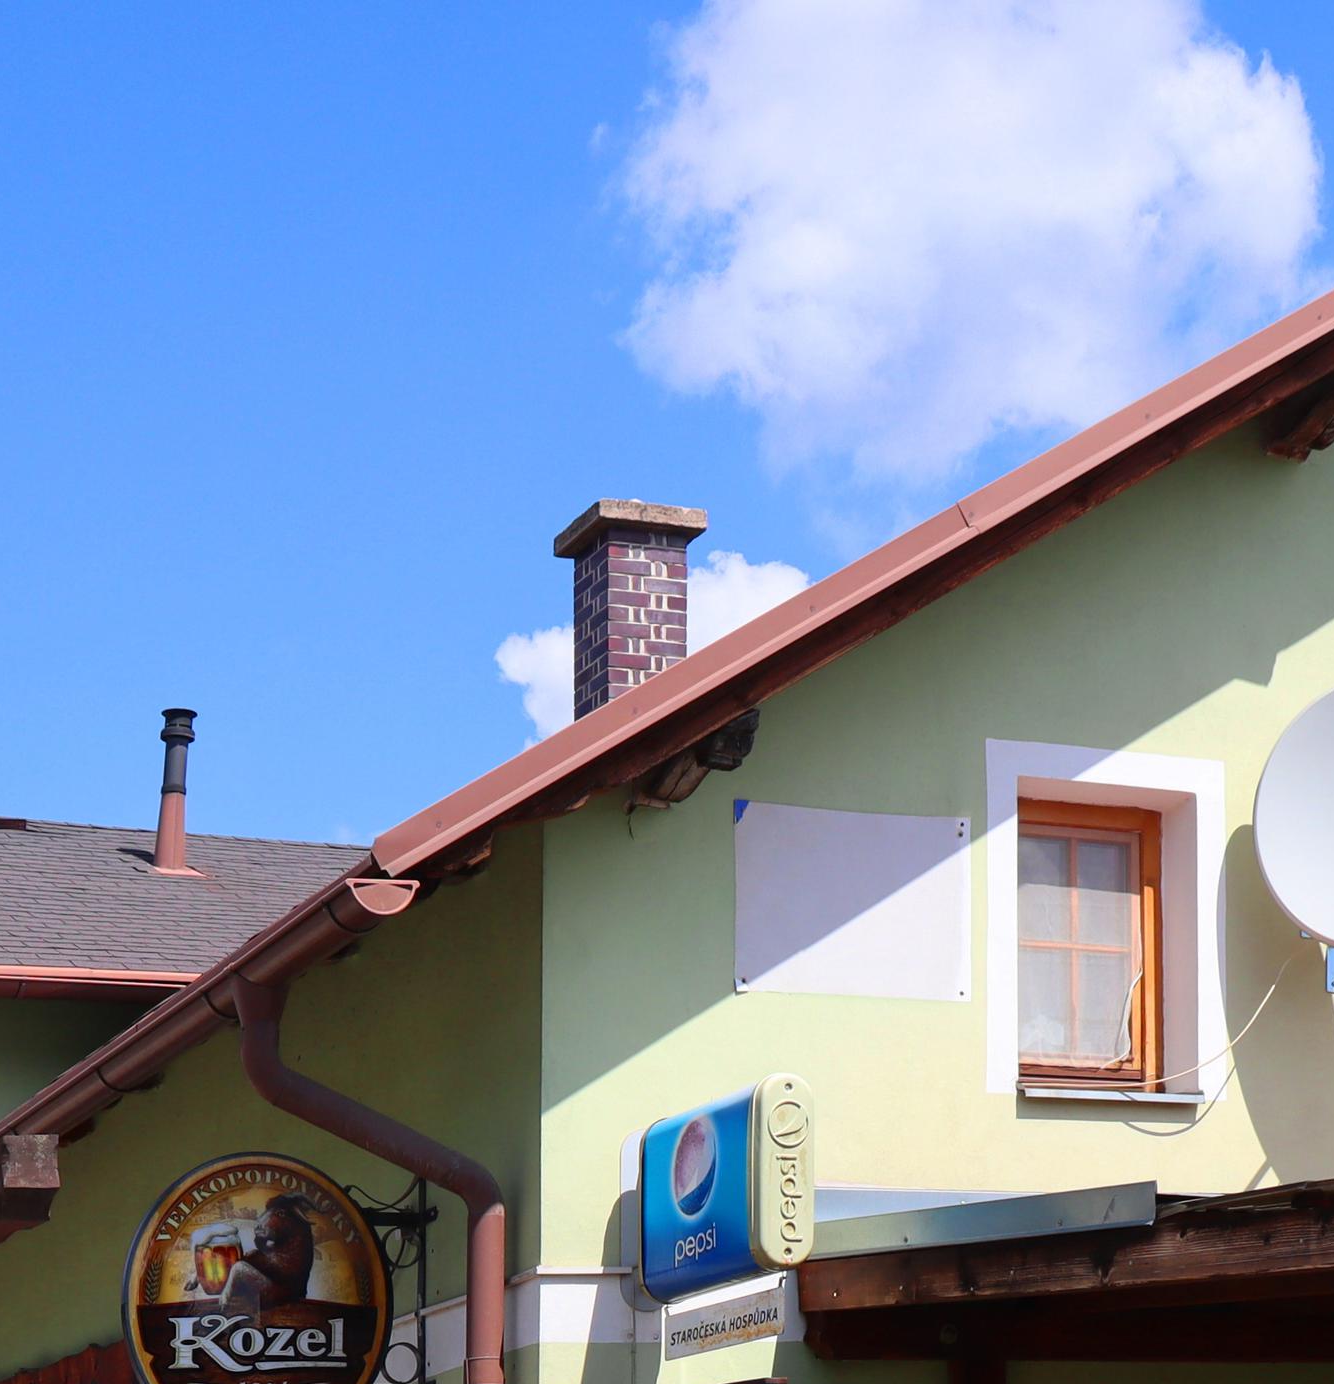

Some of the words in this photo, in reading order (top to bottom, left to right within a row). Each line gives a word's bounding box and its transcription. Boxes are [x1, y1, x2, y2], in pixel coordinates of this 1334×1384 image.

[776, 1153, 803, 1243] pepsi
[674, 1222, 716, 1267] pepsi
[168, 1314, 347, 1372] Kozel
[670, 1314, 727, 1346] STAROČESKÁ
[729, 1307, 778, 1332] HOSPŮDKA
